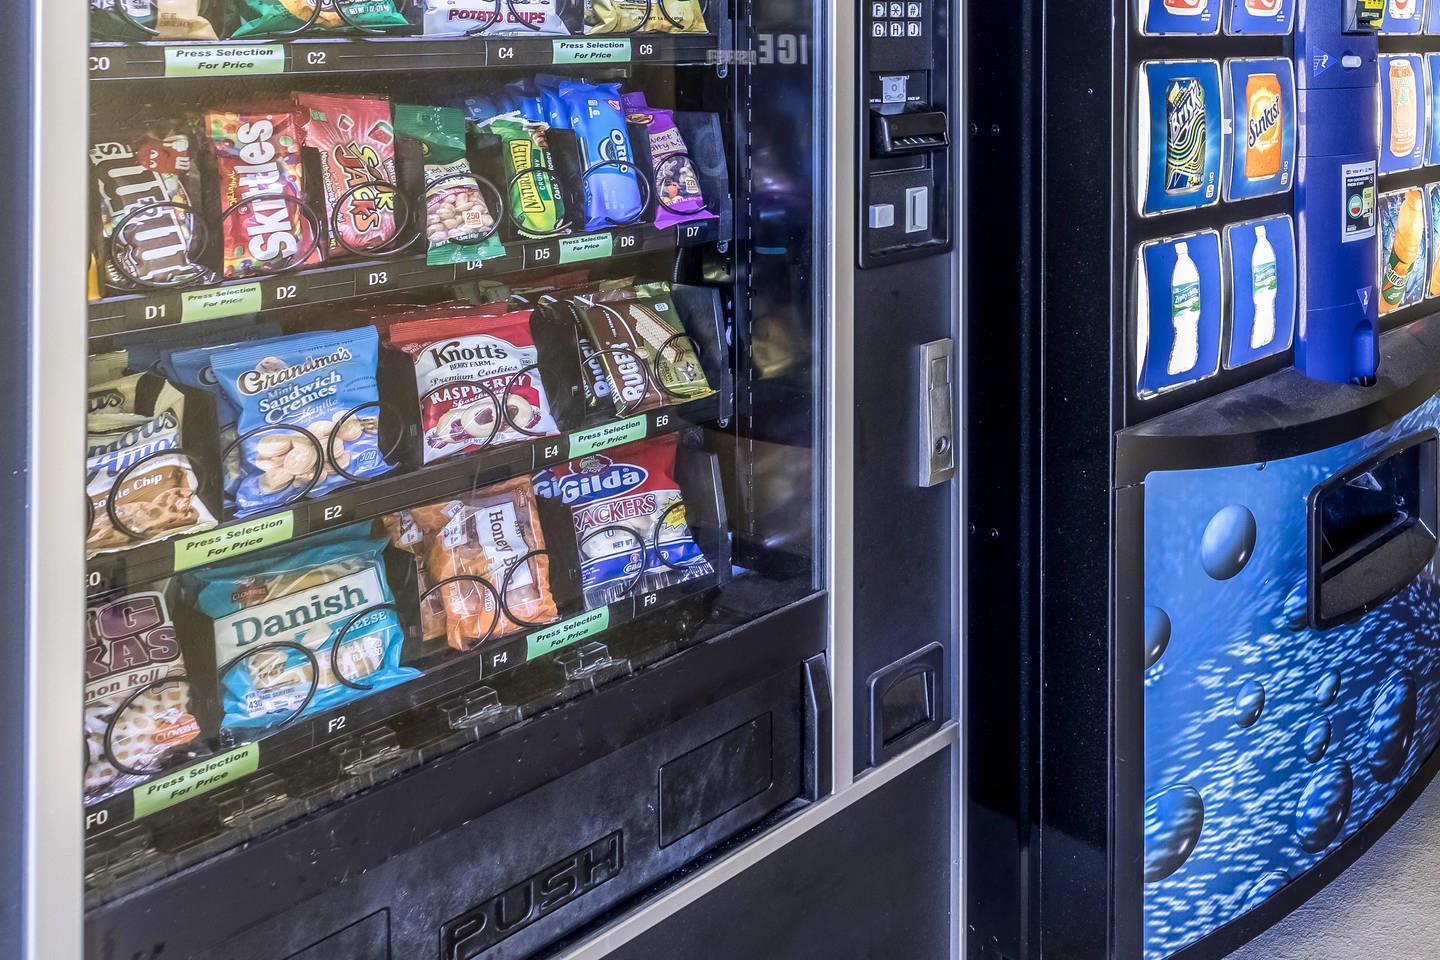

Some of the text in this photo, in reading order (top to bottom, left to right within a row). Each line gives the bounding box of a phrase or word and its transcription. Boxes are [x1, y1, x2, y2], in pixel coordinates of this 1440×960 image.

[176, 48, 274, 57] Press Selection
[498, 47, 514, 59] C4
[592, 51, 611, 59] Price
[639, 43, 653, 55] C6
[197, 60, 254, 70] For Price
[307, 52, 326, 65] C2
[237, 115, 297, 261] Skittles
[554, 183, 562, 200] Oats
[466, 212, 480, 221] 250
[687, 226, 699, 237] D7
[621, 236, 634, 246] D6
[535, 248, 550, 260] D5
[466, 260, 483, 271] D4
[369, 272, 388, 285] D3
[276, 286, 296, 299] D2
[145, 305, 166, 320] D1
[430, 341, 508, 369] Knott's
[237, 347, 352, 396] Grandma's
[449, 359, 491, 371] BERRY FARM
[430, 363, 519, 386] Premium Cookies
[259, 370, 343, 413] Sandwich
[267, 382, 293, 399] Mini
[265, 384, 337, 424] Cremes
[656, 415, 668, 427] E6
[544, 446, 558, 458] E4
[133, 474, 162, 490] Chip
[562, 469, 640, 504] Gilda
[324, 505, 343, 520] E2
[185, 518, 284, 551] Press Selection
[489, 510, 512, 552] Honey
[207, 536, 264, 557] For Price
[644, 593, 657, 606] F6
[232, 585, 369, 647] Danish
[493, 654, 507, 667] F4
[128, 669, 160, 687] Roll
[328, 716, 346, 732] F2
[147, 749, 249, 795] Press Selection
[170, 771, 228, 800] For Price
[86, 809, 108, 830] F0
[447, 834, 620, 960] PUSH
